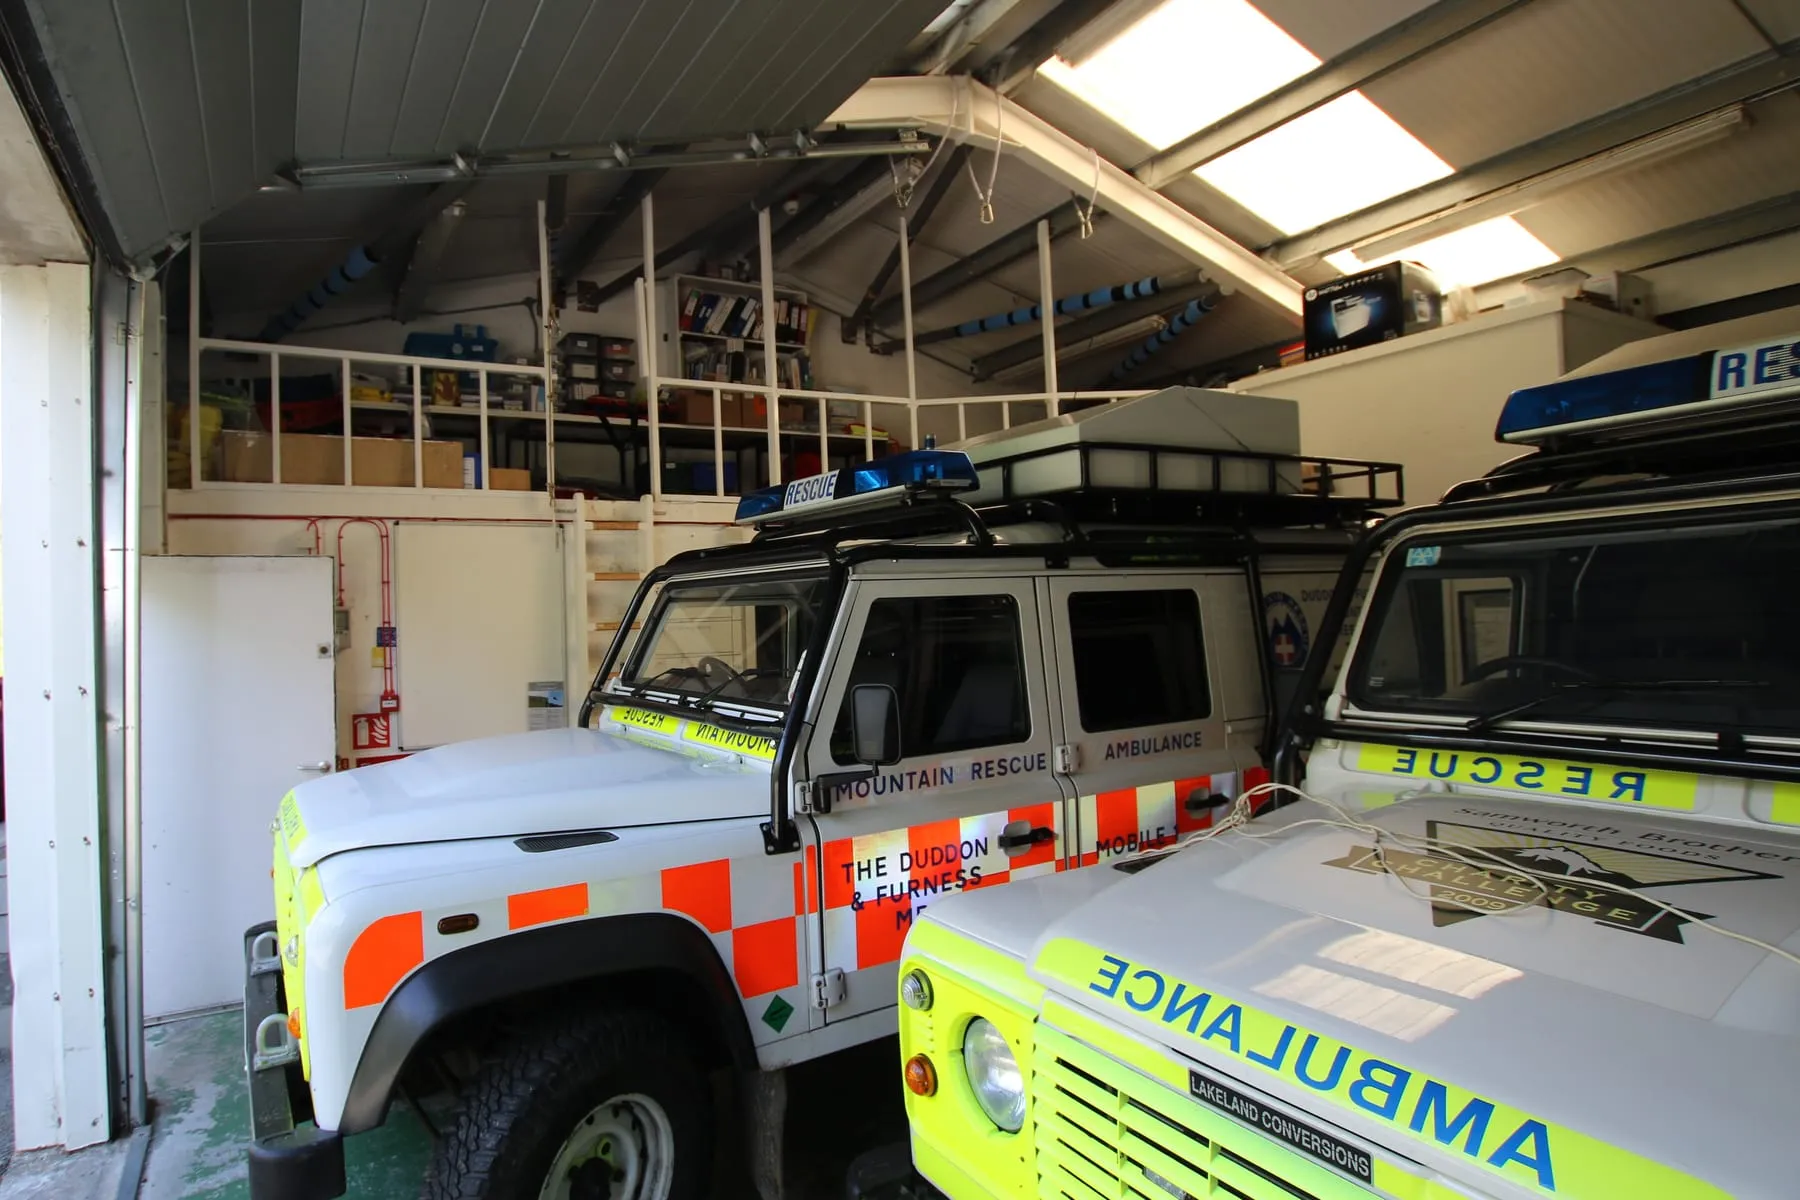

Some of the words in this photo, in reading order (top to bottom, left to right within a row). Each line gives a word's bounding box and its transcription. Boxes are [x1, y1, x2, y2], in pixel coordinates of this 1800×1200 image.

[785, 473, 837, 506] RESCUE
[1105, 731, 1202, 761] AMBULANCE
[835, 766, 954, 802] MOUNTAIN
[971, 753, 1047, 780] RESCUE
[1453, 808, 1622, 835] Samworth
[1096, 826, 1165, 860] MOBILE
[1489, 822, 1607, 841] QUALITY
[1618, 840, 1721, 860] FOODS
[841, 856, 888, 883] THE
[899, 837, 988, 873] DUDDON
[851, 891, 866, 911] &
[876, 866, 983, 906] FURNESS
[1437, 890, 1507, 911] 2009
[1191, 1075, 1259, 1123] LAKELAND
[1261, 1111, 1370, 1178] CONVERSIONS
